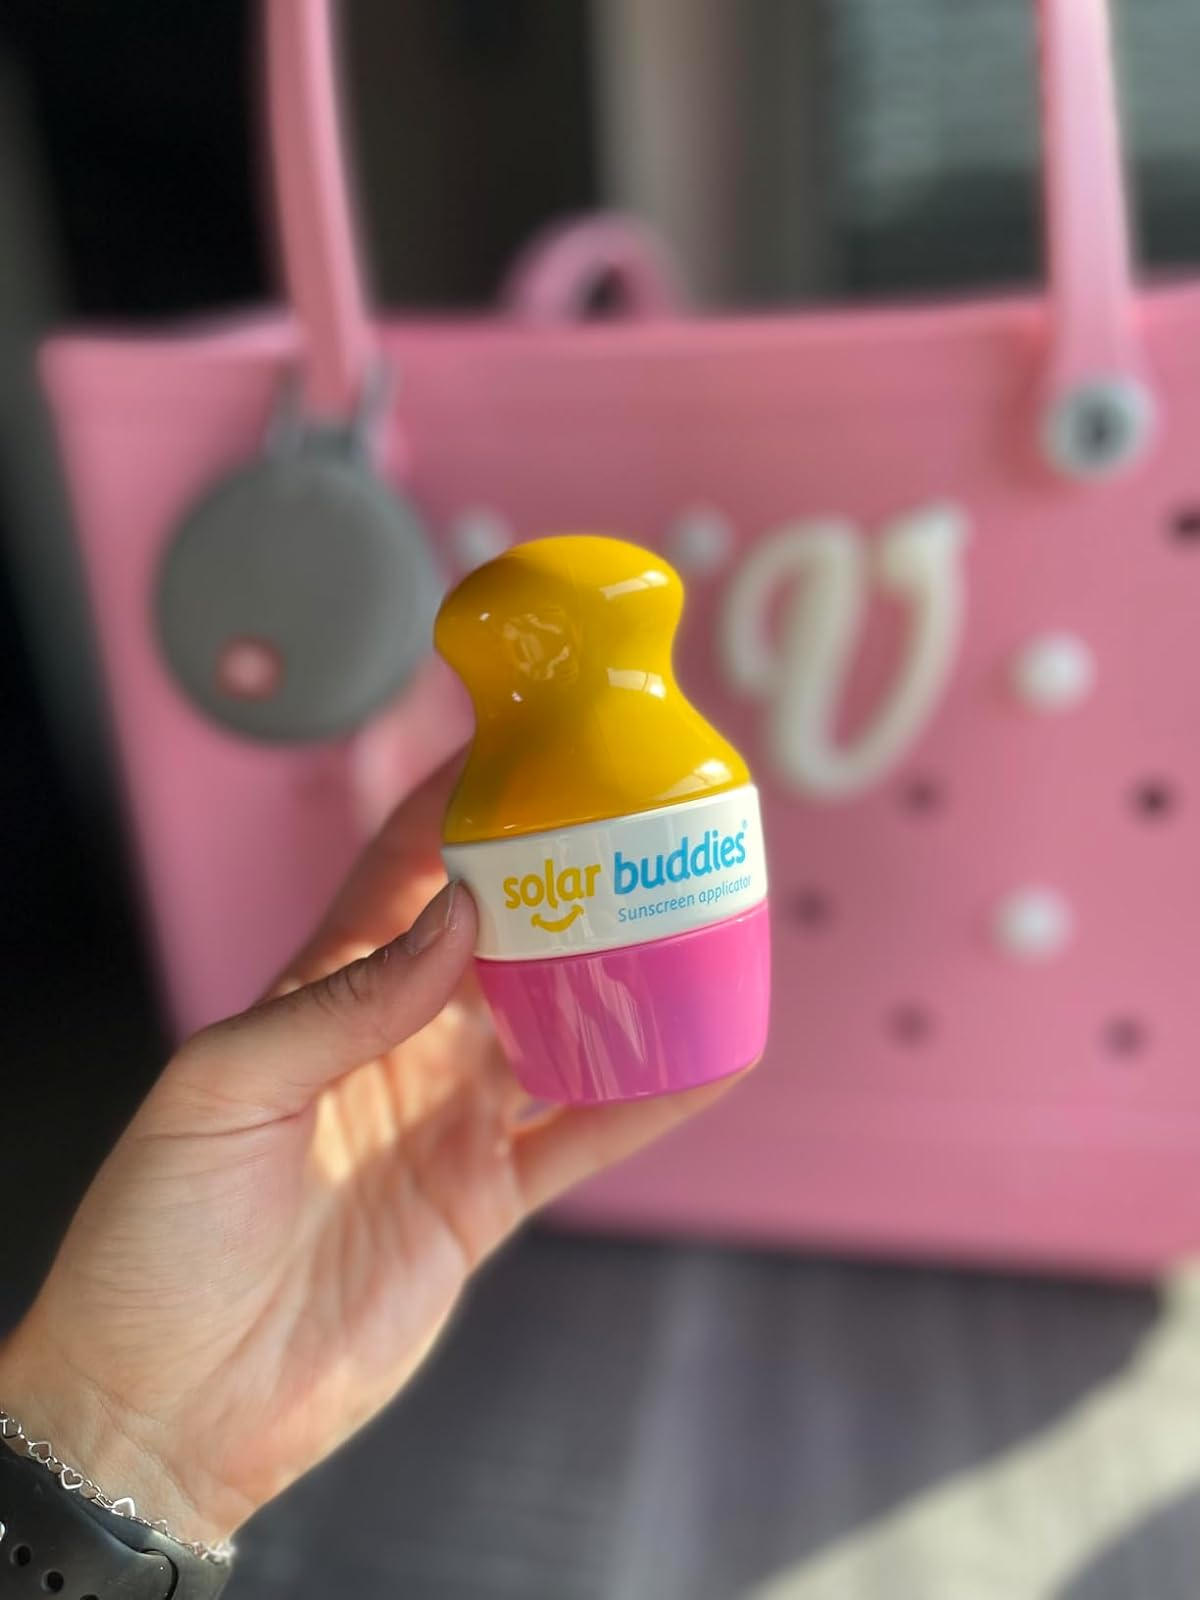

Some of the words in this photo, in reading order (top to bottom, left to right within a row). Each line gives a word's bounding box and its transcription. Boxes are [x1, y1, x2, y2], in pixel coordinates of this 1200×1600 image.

[503, 859, 601, 910] solar
[614, 829, 746, 895] buddies
[617, 895, 696, 922] Sunscreen
[699, 875, 752, 904] applicator
